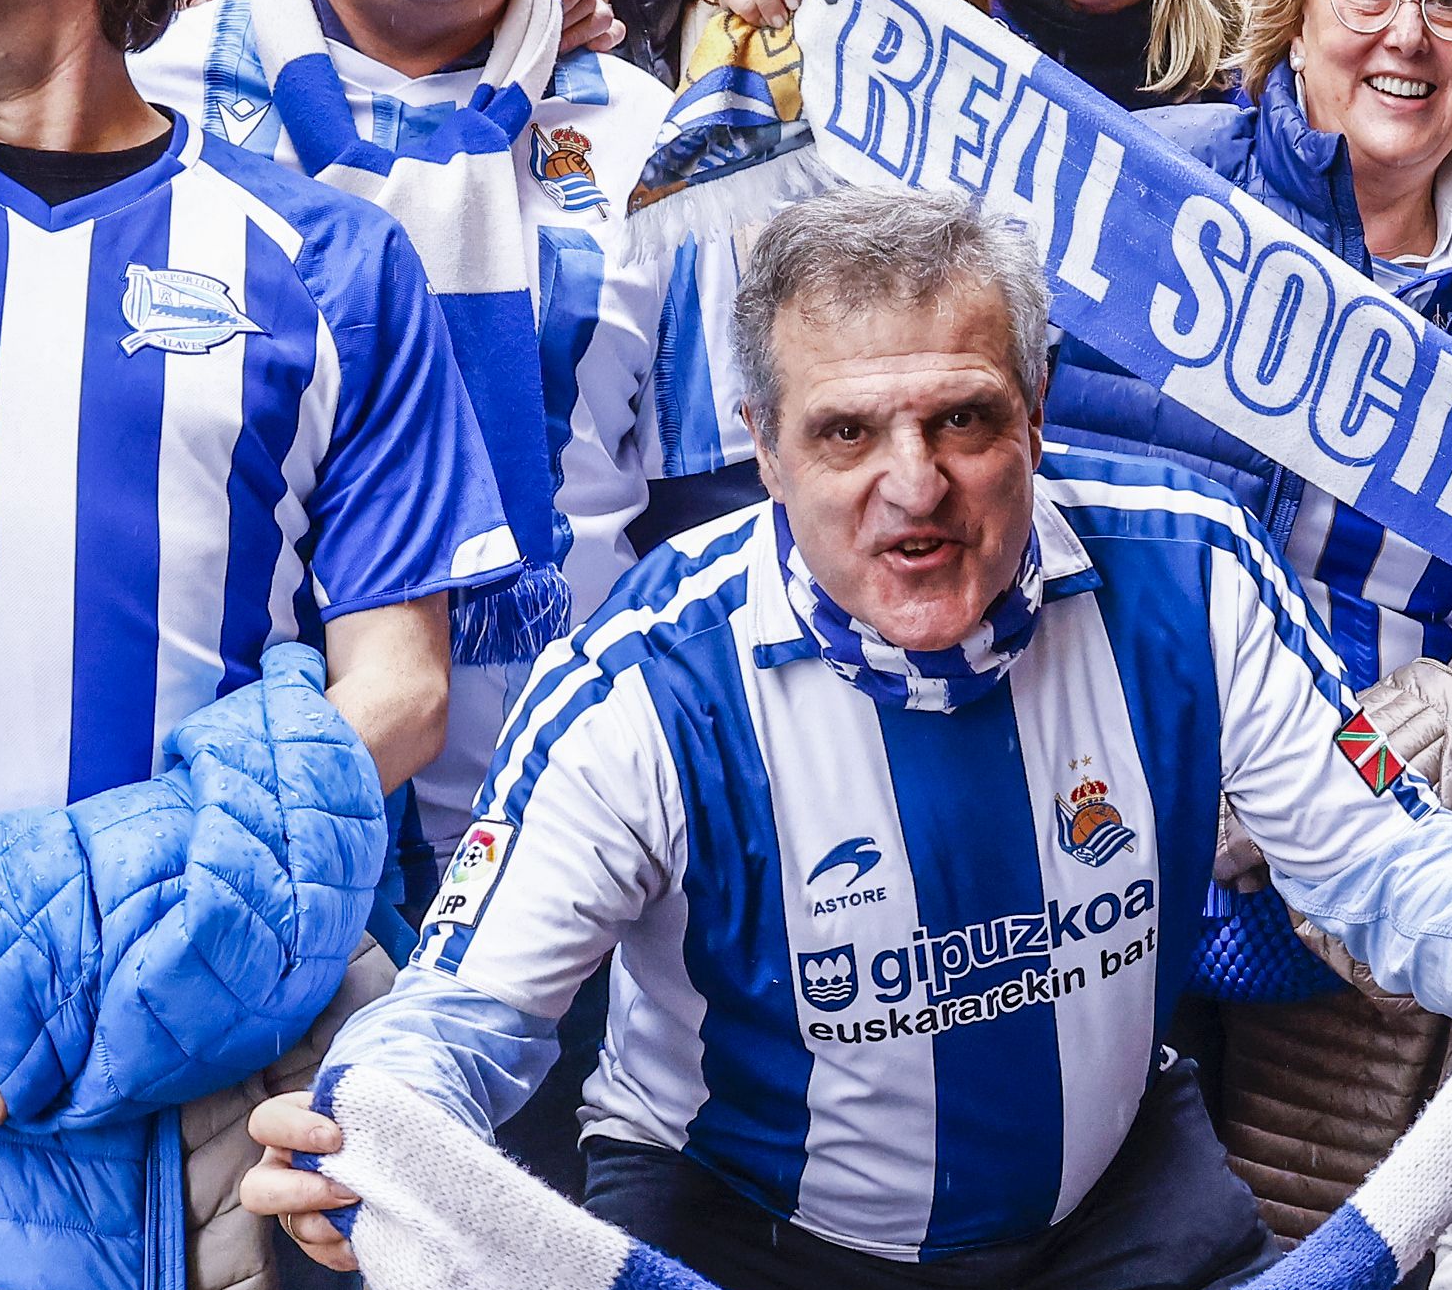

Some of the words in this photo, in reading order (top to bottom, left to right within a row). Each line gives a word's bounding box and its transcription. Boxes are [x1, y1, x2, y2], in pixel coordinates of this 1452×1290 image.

[154, 272, 222, 294] DEPORTIVO
[158, 337, 206, 351] ALAVES
[812, 886, 888, 917] ASTORE
[870, 877, 1156, 1004] gipuzkoa
[808, 965, 1086, 1045] euskararekin
[1100, 925, 1156, 980] bat
